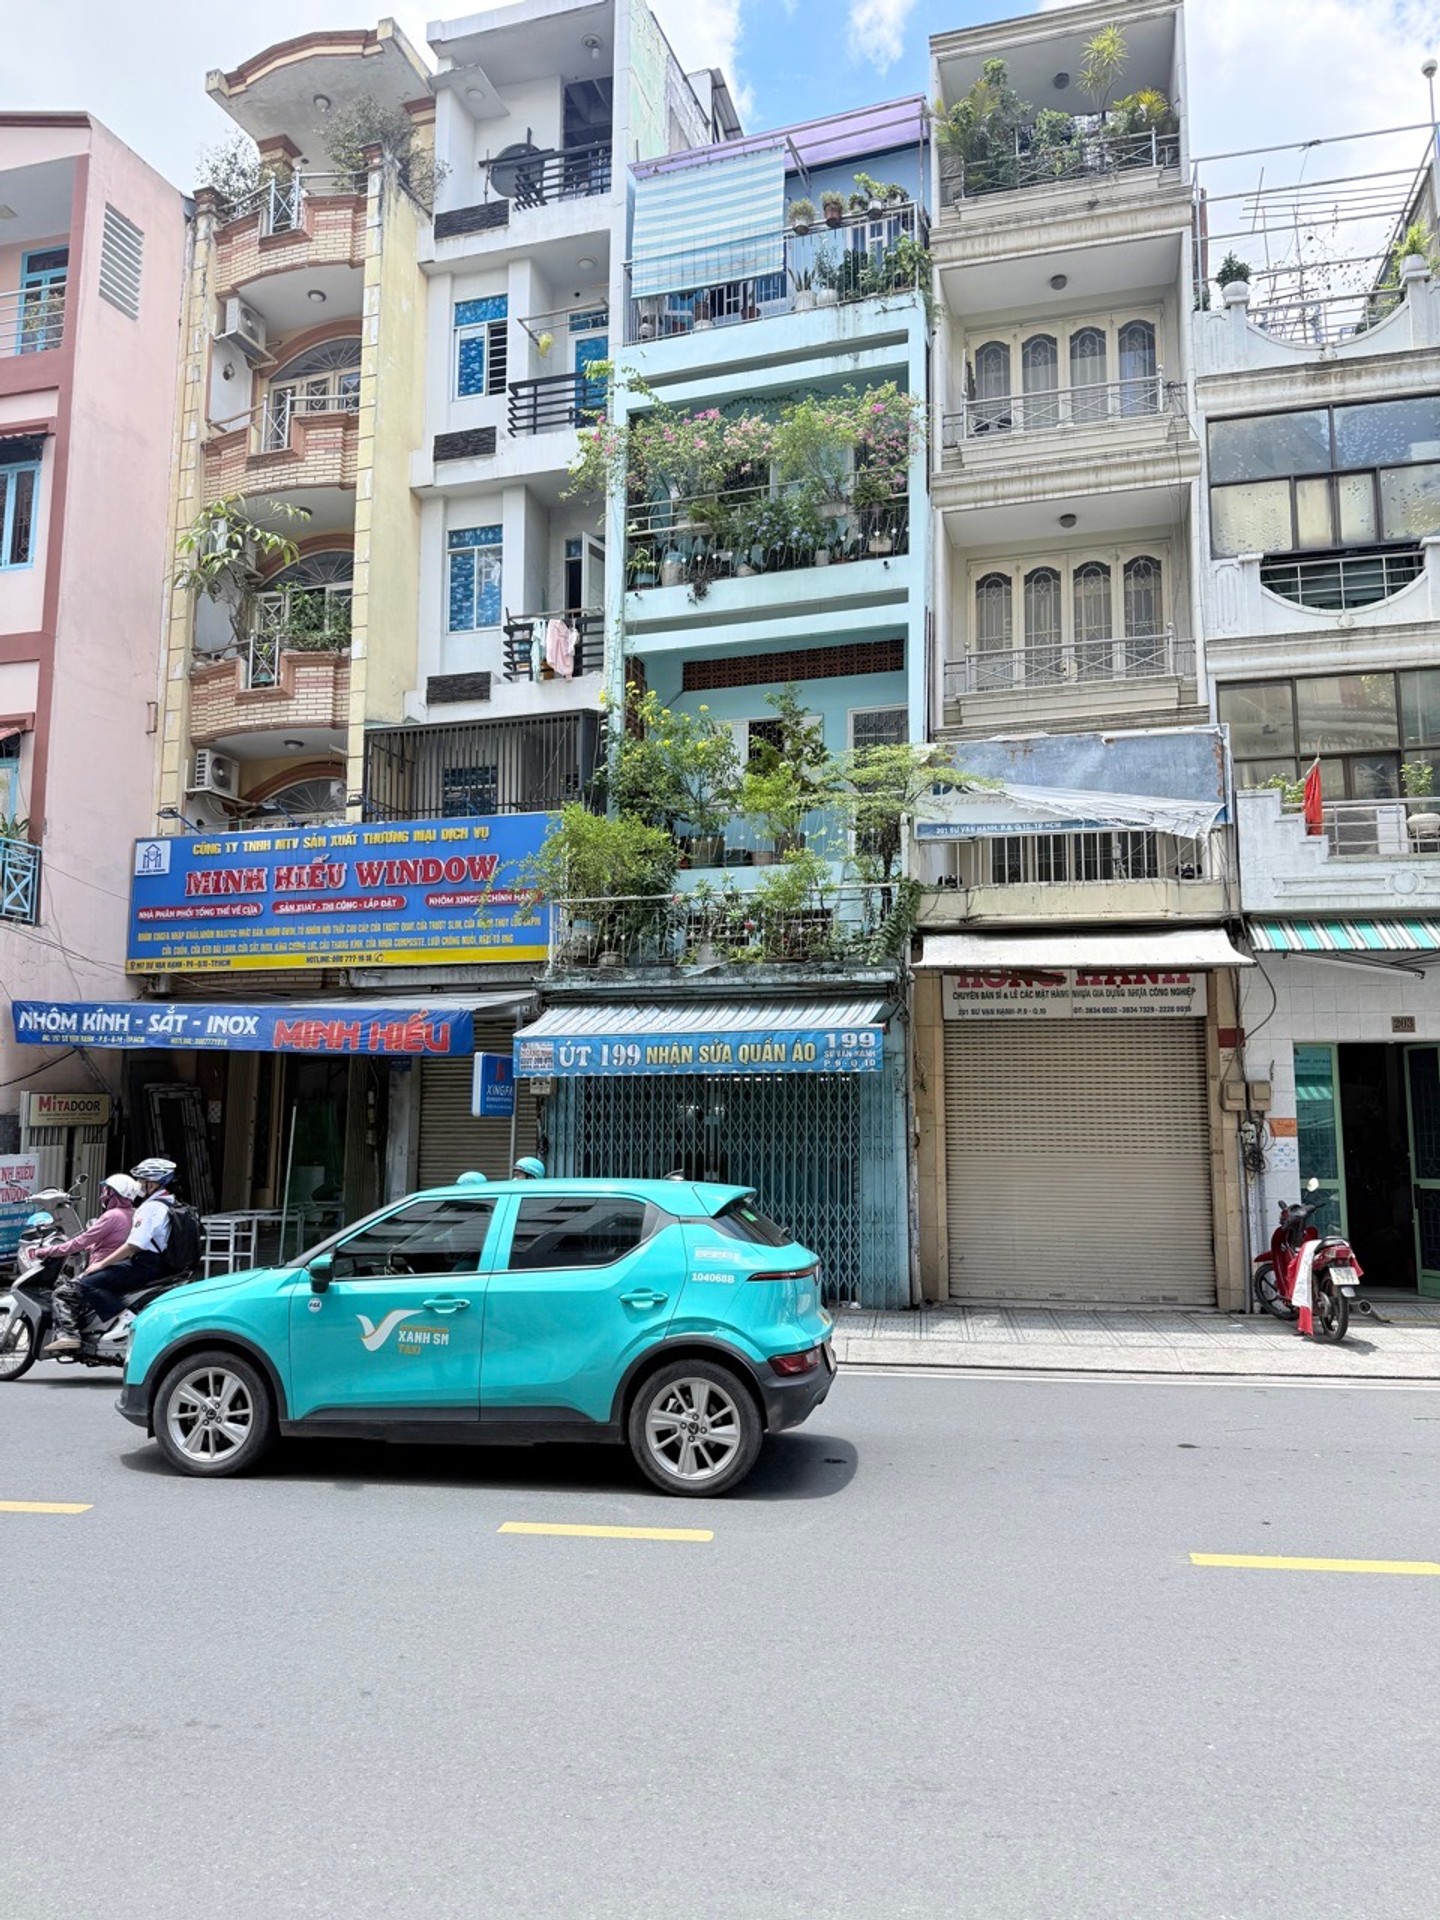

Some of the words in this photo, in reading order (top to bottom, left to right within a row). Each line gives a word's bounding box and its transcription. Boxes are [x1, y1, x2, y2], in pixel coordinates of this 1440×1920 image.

[192, 841, 222, 856] CÔNG
[225, 841, 239, 854] TY
[242, 839, 271, 852] TNHH
[274, 838, 299, 850] MTV
[303, 833, 326, 848] SẢN
[330, 831, 358, 847] XUẤT
[363, 829, 409, 844] THƯƠNG
[413, 828, 437, 844] MẠI
[441, 826, 469, 843] DỊCH
[473, 825, 490, 841] VỤ
[185, 867, 268, 897] MINH
[273, 853, 348, 893] HIẾU
[354, 854, 499, 888] WINDOW
[279, 902, 295, 912] SẢN
[296, 901, 316, 912] XUẤT
[335, 900, 357, 910] CÔNG
[364, 897, 379, 908] LẮP
[429, 894, 454, 905] NHÔM
[487, 892, 512, 903] CHÍNH
[138, 910, 153, 919] NHÀ
[155, 908, 175, 918] PHÂN
[176, 907, 193, 918] PHỐI
[242, 903, 258, 915] CỬA
[953, 989, 979, 1001] CHUYÊN
[981, 988, 995, 999] BÁN
[1020, 988, 1034, 999] CÁC
[1035, 988, 1050, 1001] MẶT
[1072, 988, 1091, 1000] NHỰA
[1092, 987, 1105, 998] GIA
[1105, 987, 1126, 1000] DỤNG
[1128, 987, 1148, 999] NHỰA
[1149, 985, 1169, 997] CÔNG
[1170, 985, 1196, 998] NGHIỆP
[19, 1008, 79, 1032] NHÔM
[83, 1007, 131, 1033] KÍNH
[148, 1004, 189, 1034] SẮT
[206, 1014, 260, 1036] INOX
[273, 1018, 361, 1051] MINH
[368, 1008, 451, 1053] HIẾU
[1392, 1017, 1413, 1029] 203
[824, 1031, 876, 1049] 199
[559, 1040, 592, 1068] ÚT
[601, 1042, 642, 1067] 199
[646, 1040, 693, 1069] NHẬN
[699, 1038, 733, 1064] SỬA
[738, 1036, 787, 1065] QUẦN
[792, 1038, 816, 1062] ÁO
[691, 1271, 736, 1284] 104068B
[398, 1329, 430, 1344] XANH
[433, 1332, 449, 1346] SM
